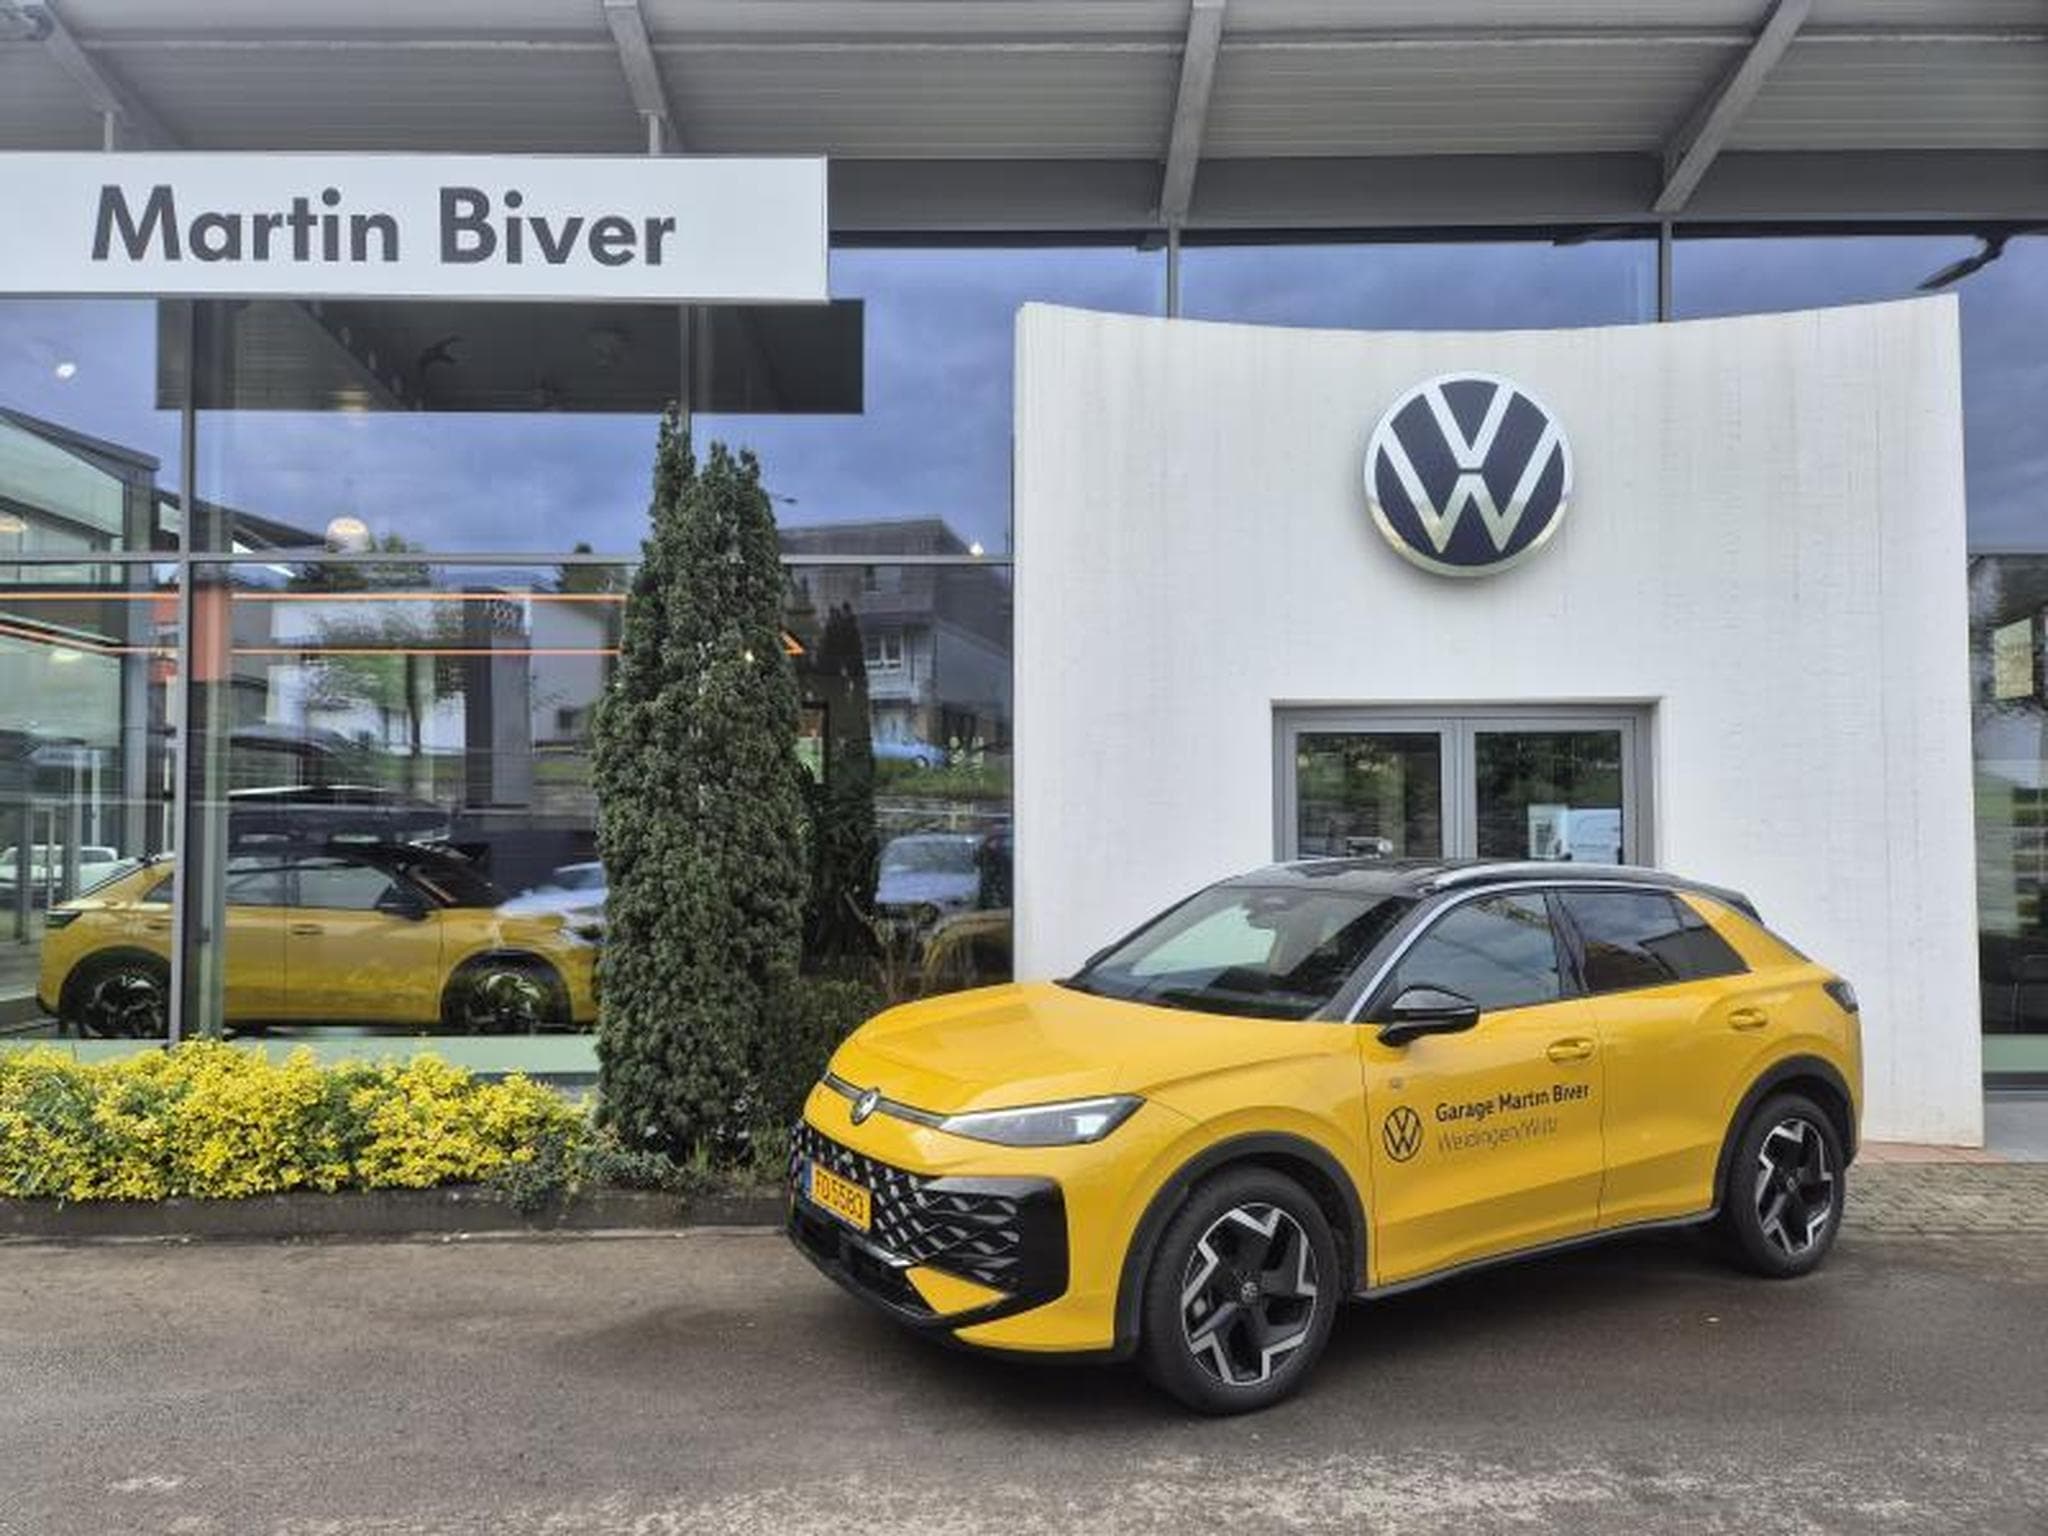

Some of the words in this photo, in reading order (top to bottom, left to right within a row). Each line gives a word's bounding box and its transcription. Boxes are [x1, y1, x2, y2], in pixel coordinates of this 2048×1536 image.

[91, 184, 400, 262] Martin
[438, 186, 676, 266] Biver
[1436, 1101, 1494, 1121] Garage
[1499, 1092, 1550, 1112] Martin
[1553, 1084, 1589, 1103] Biver
